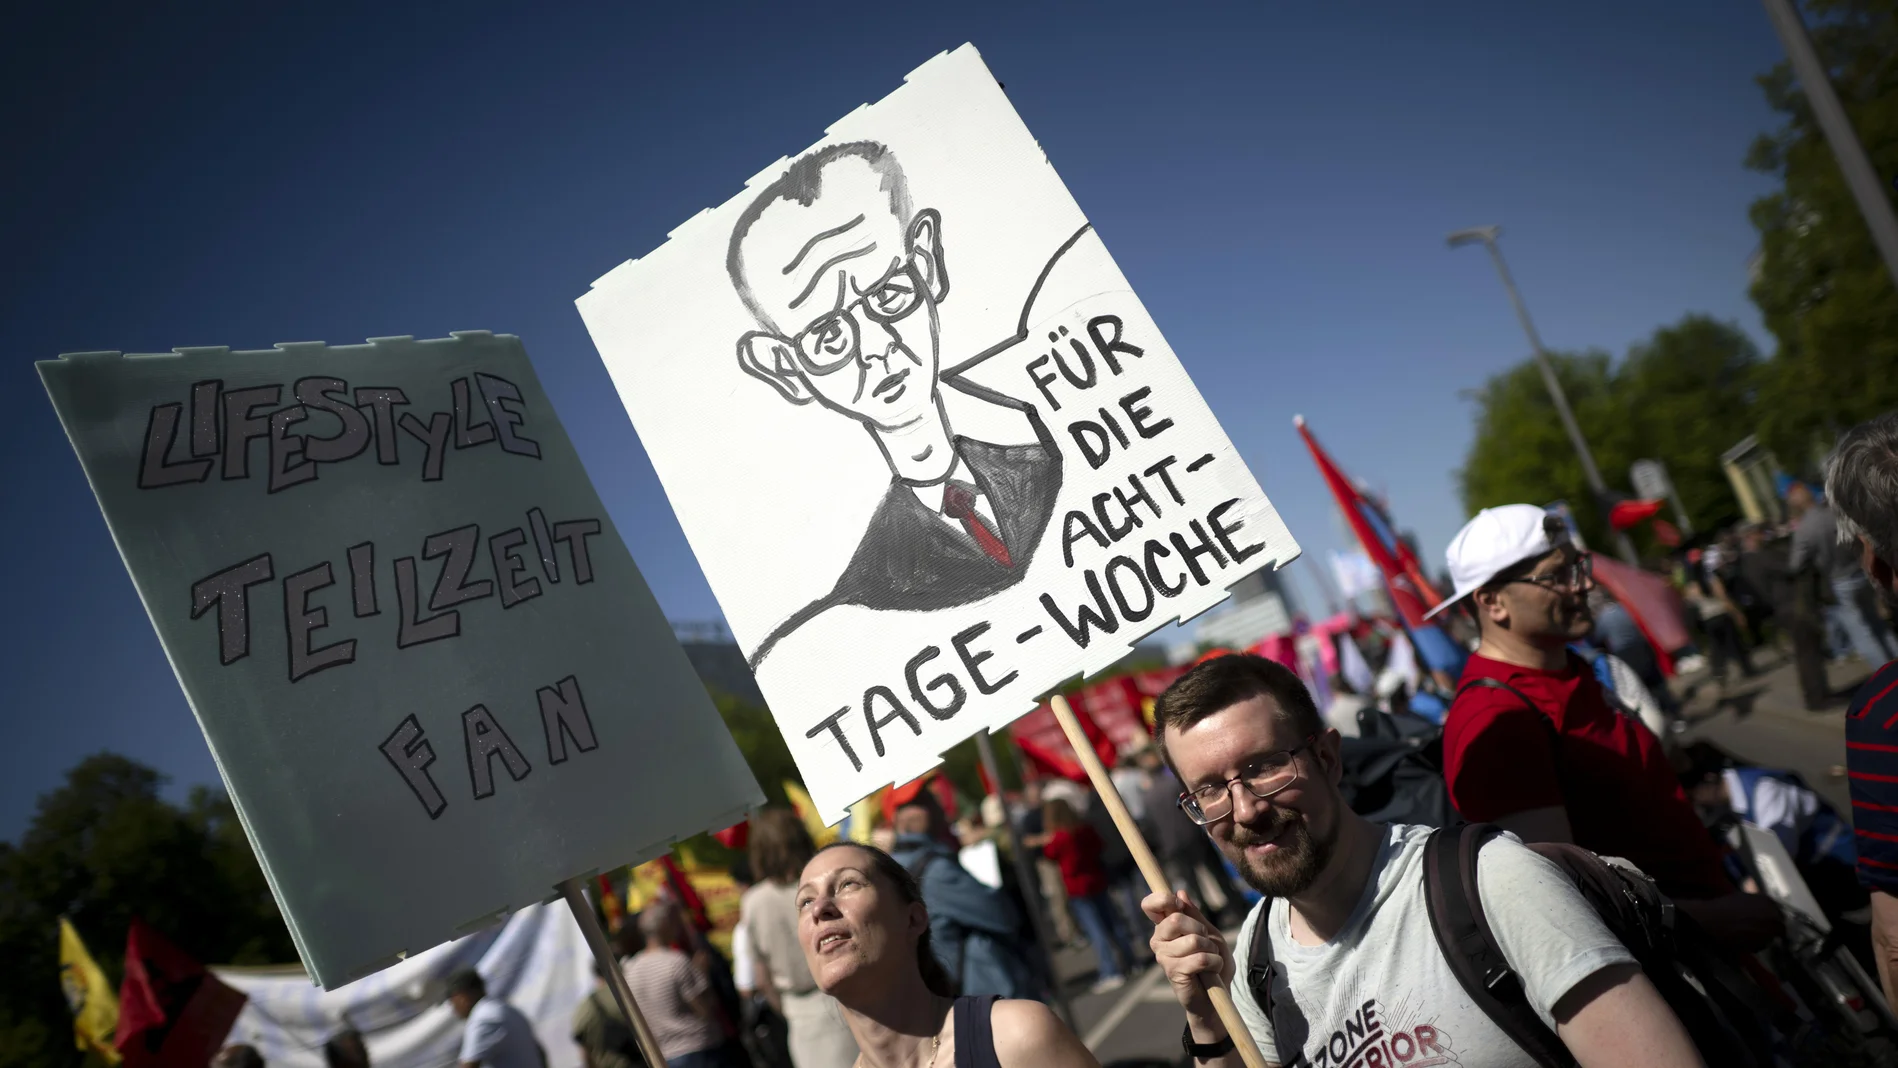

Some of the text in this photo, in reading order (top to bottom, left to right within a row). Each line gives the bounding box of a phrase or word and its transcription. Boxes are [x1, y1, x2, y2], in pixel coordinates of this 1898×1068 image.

[1025, 314, 1144, 411] FÜR
[138, 372, 541, 493] LIFESTYLE
[1067, 386, 1174, 470] DIE
[1061, 453, 1215, 567] ACHT-
[191, 508, 600, 682] TEILZEIT
[379, 675, 598, 819] FAN
